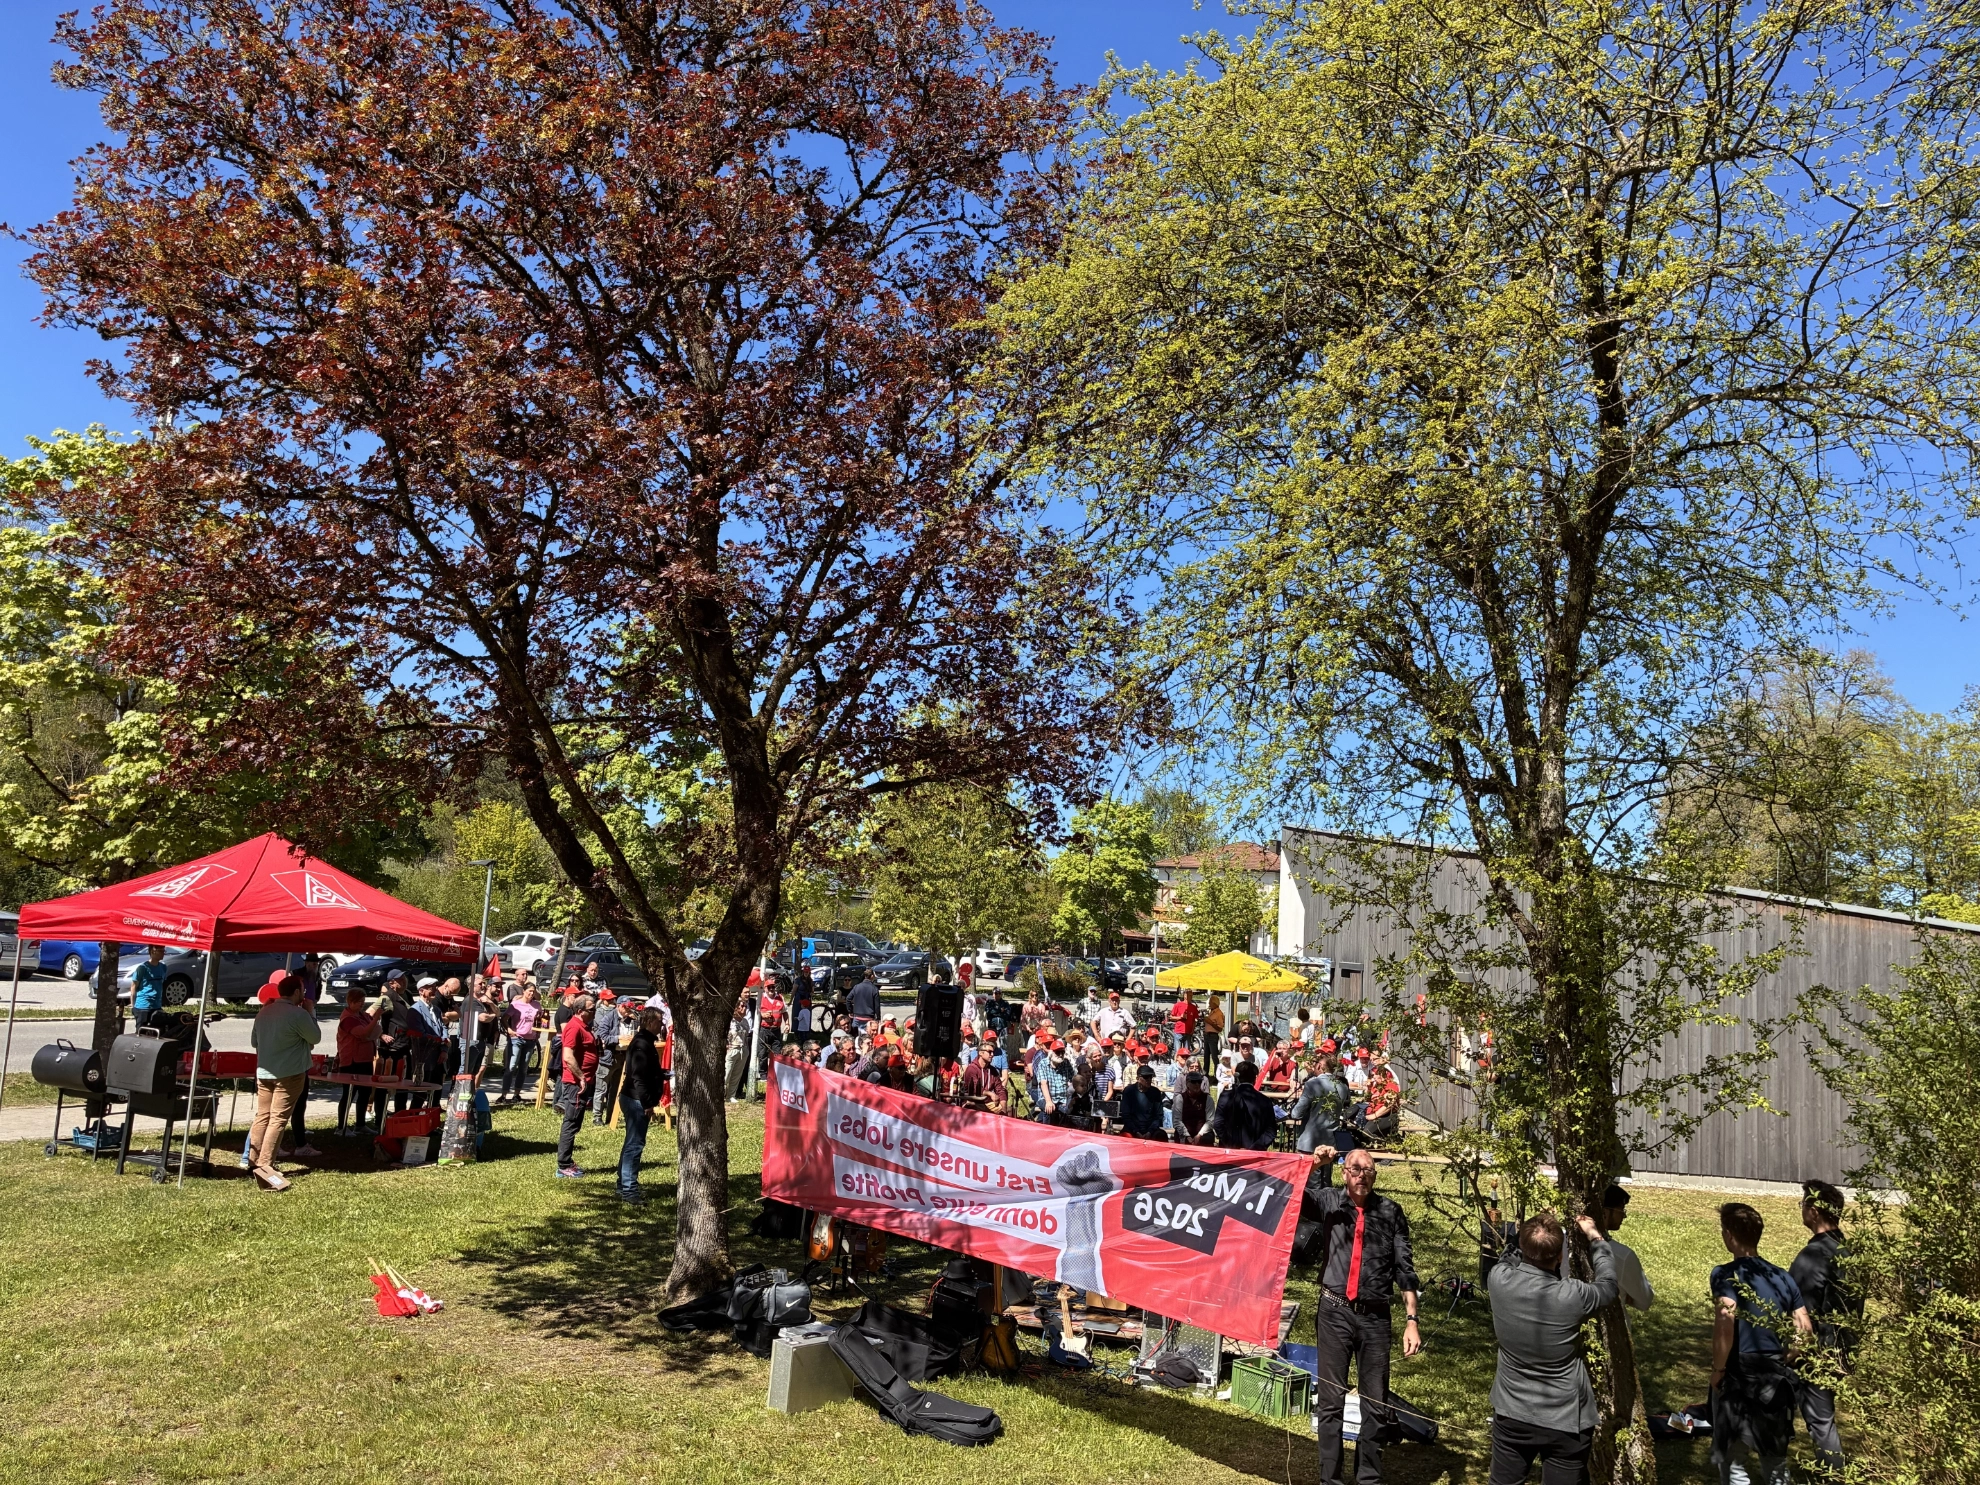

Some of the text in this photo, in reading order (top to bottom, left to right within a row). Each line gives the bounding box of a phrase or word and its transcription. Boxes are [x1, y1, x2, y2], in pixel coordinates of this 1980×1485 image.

[142, 928, 159, 937] GUTES
[400, 944, 419, 952] GUTES
[420, 945, 440, 954] LEBEN
